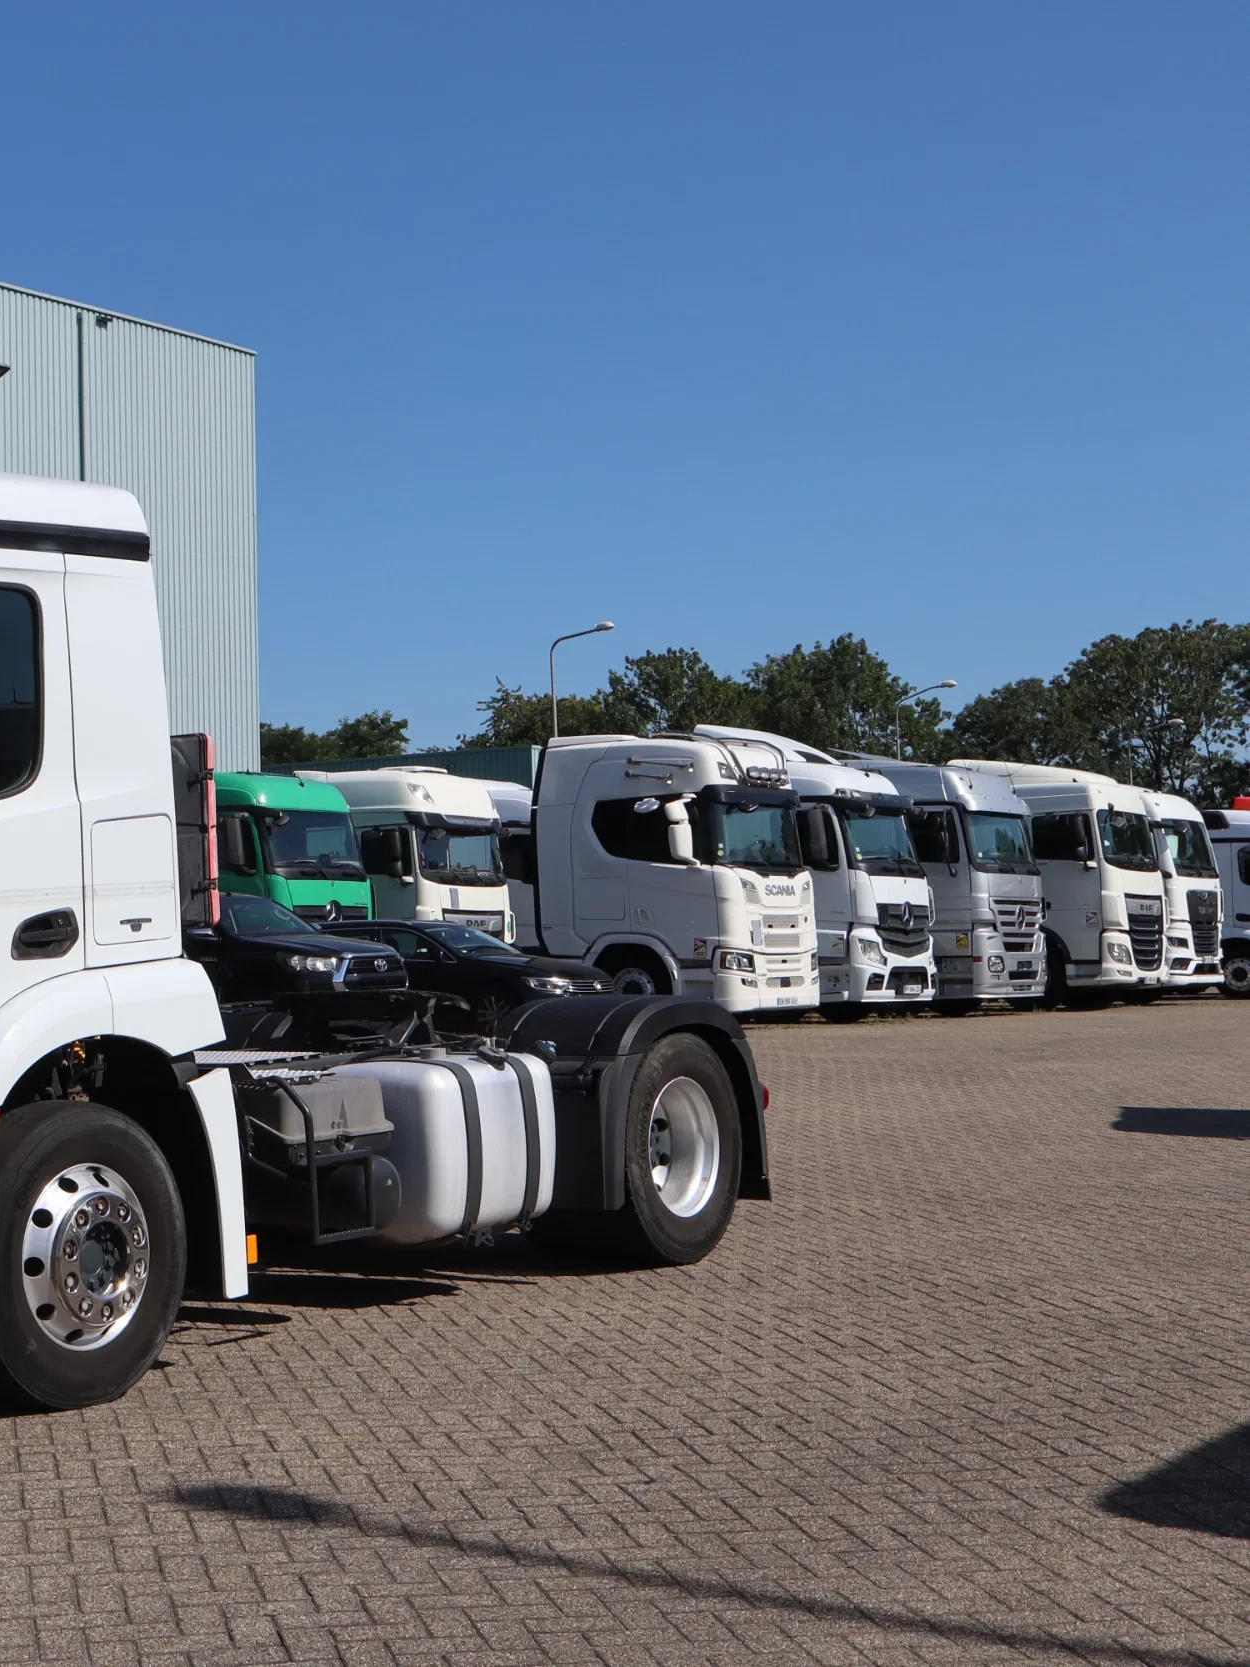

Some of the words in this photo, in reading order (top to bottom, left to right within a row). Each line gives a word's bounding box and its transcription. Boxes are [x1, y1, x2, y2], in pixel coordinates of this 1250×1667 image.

[765, 884, 796, 896] SCANIA
[1139, 903, 1153, 911] DAF
[466, 919, 486, 927] DAF
